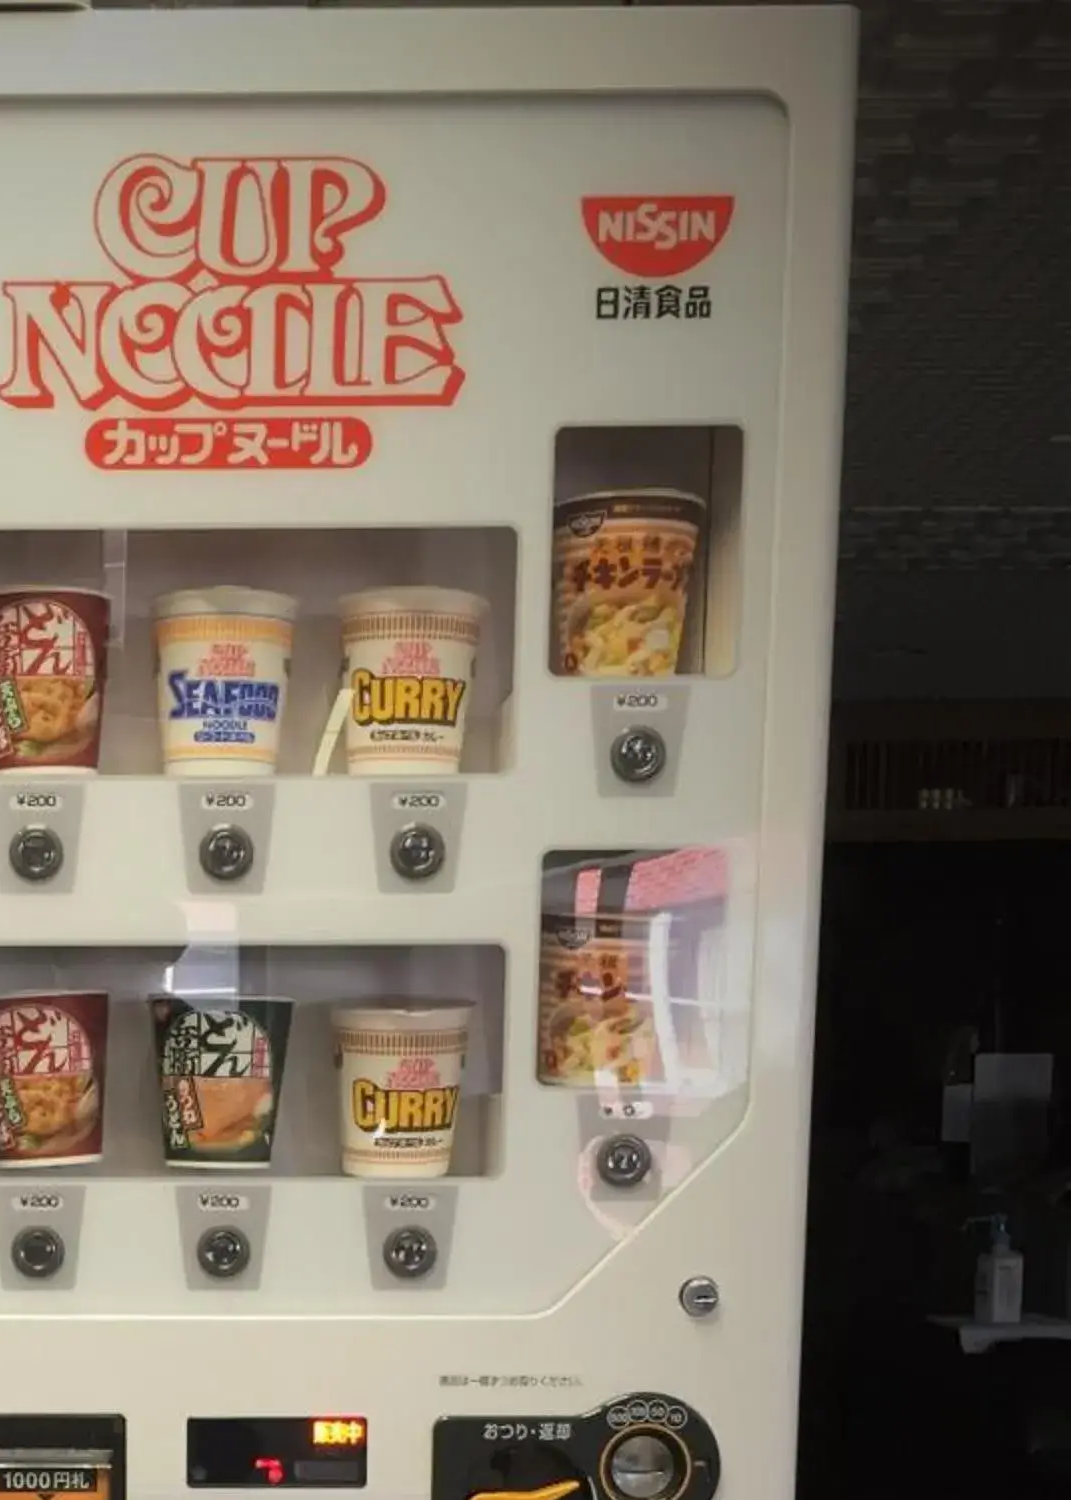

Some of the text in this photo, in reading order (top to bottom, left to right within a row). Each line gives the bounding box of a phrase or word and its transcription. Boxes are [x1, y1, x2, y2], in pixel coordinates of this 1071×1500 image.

[94, 153, 386, 279] CUP
[596, 205, 716, 252] NISSIN
[594, 286, 712, 320] 日清食品
[168, 669, 280, 722] SEAFOOD
[351, 667, 466, 728] CURRY
[616, 694, 658, 708] ¥200
[202, 719, 249, 731] NOODLE
[15, 793, 57, 807] ¥200
[206, 793, 247, 808] ¥200
[398, 794, 439, 808] ¥200
[352, 1077, 460, 1134] CURRY
[19, 1195, 59, 1208] ¥200
[199, 1194, 240, 1208] ¥200
[389, 1195, 429, 1209] ¥200
[482, 1422, 572, 1441] おつり・返却
[3, 1471, 90, 1490] 1000円札
